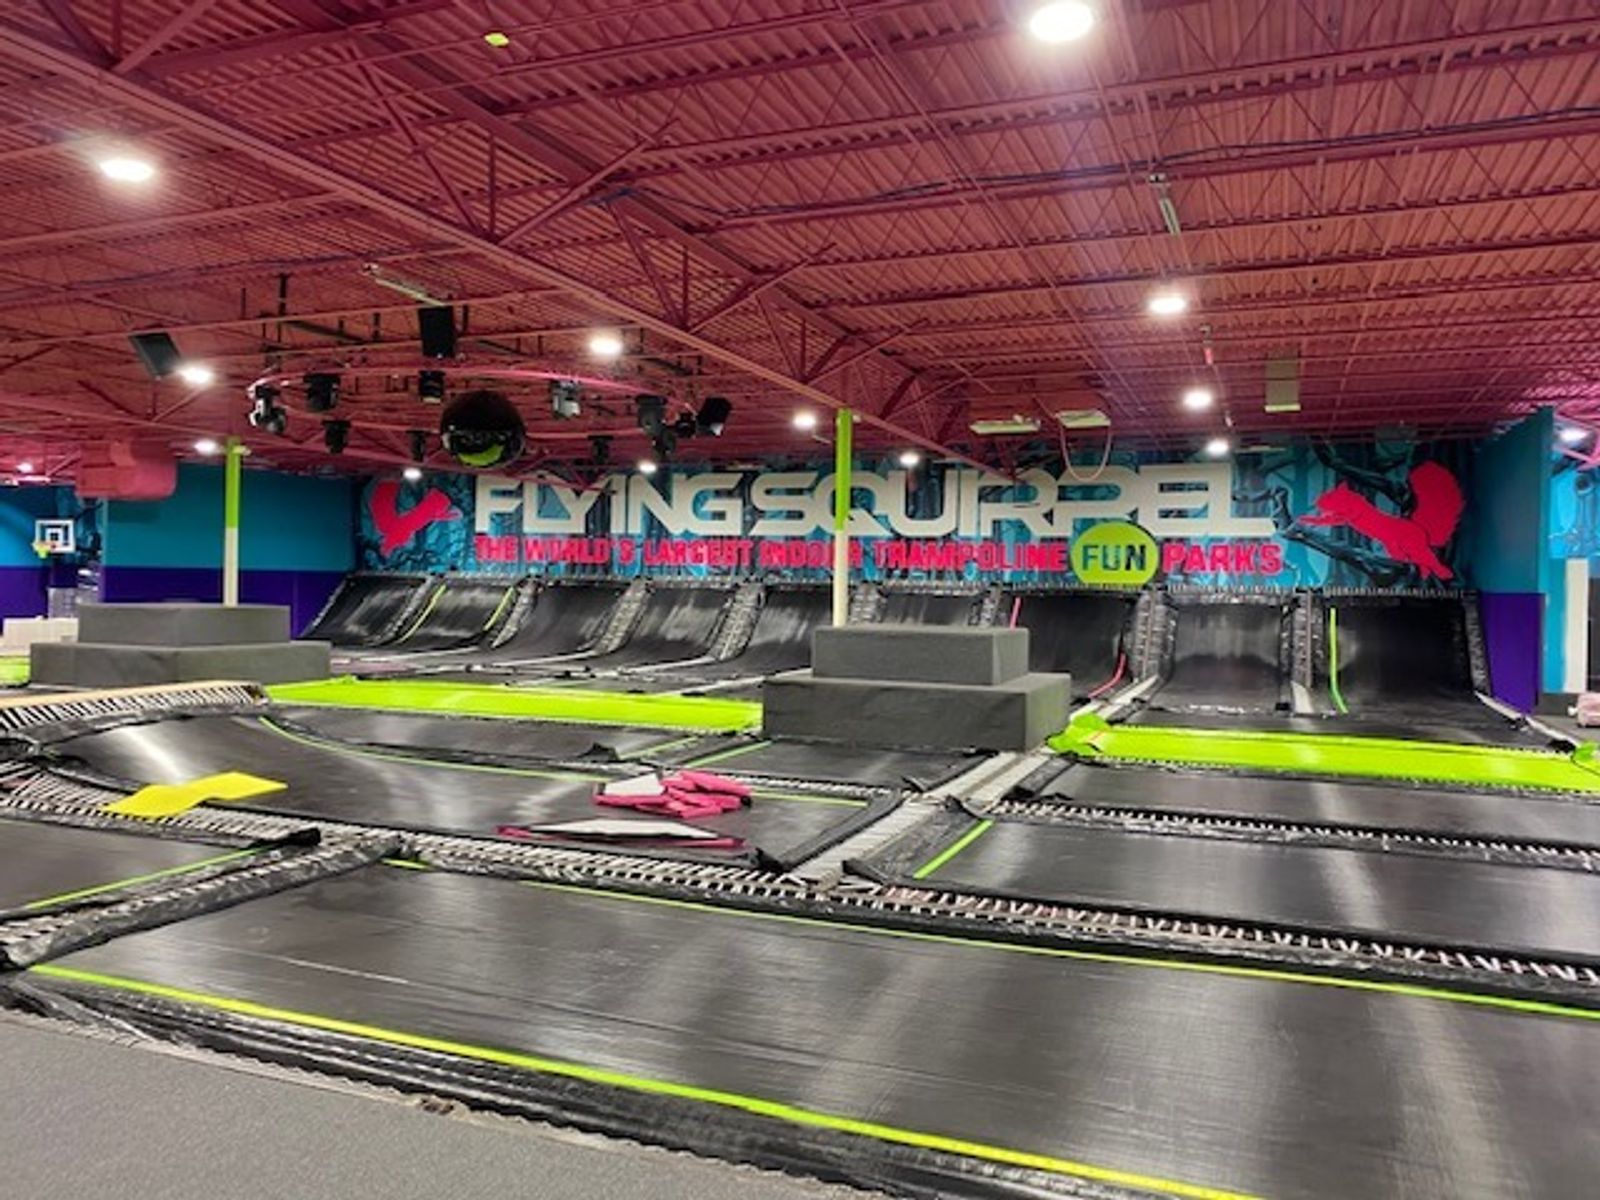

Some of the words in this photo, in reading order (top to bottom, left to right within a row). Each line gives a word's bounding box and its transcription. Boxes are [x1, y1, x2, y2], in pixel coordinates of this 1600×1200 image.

[475, 472, 743, 534] FLYING
[749, 464, 1277, 538] SQUIRREL
[475, 536, 516, 561] THE
[525, 537, 636, 564] WORLD'S
[644, 538, 753, 566] LARGEST
[874, 540, 1067, 572] TRAMPOLINE
[1082, 545, 1147, 571] FUN
[1162, 542, 1282, 574] PARKS
